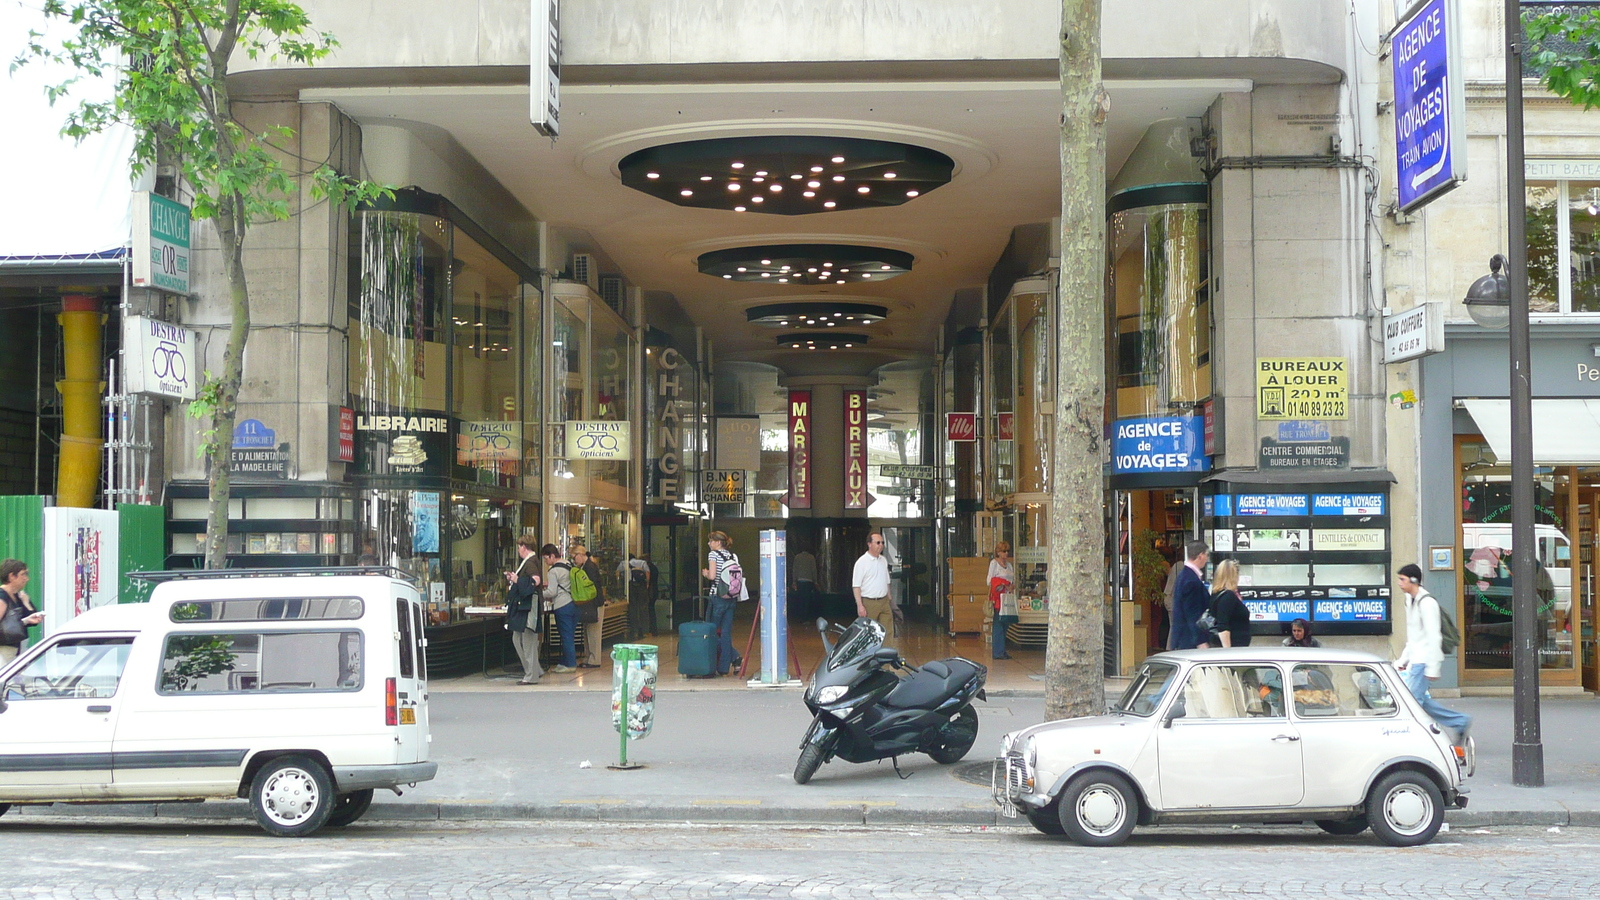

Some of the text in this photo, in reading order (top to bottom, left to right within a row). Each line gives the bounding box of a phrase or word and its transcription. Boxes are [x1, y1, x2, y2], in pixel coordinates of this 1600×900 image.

[1398, 8, 1441, 68] AGENCE
[1412, 59, 1427, 92] DE
[1398, 86, 1442, 141] VOYAGES
[1401, 128, 1442, 172] TRAIN AVION
[1525, 163, 1557, 175] PETIT
[151, 201, 187, 241] CHANGE
[162, 244, 176, 276] OR
[1387, 311, 1423, 340] CLUB COIFFURE
[150, 320, 187, 344] DESTRAY
[1261, 361, 1344, 371] BUREAUX
[1267, 372, 1338, 385] À LOUER
[159, 381, 182, 395] Opticiens
[1288, 401, 1344, 416] 01 40 89 23 23
[244, 422, 256, 434] 11
[357, 415, 448, 433] LIBRAIRIE
[575, 423, 622, 431] DESTRAY
[658, 347, 680, 501] CHANGE
[950, 417, 973, 438] illy
[1118, 422, 1182, 439] AGENCE
[1280, 430, 1293, 439] RUE
[243, 436, 273, 444] TRONCHET
[1137, 440, 1151, 451] de
[580, 450, 614, 458] Opticiens
[849, 394, 862, 506] BUREAUX
[1262, 446, 1344, 455] CENTRE COMMERCIAL
[1116, 453, 1188, 469] VOYAGES
[1270, 458, 1299, 466] BUREAUX
[1302, 458, 1311, 466] EN
[230, 463, 284, 472] LA MADELEINE
[706, 472, 740, 482] B.N.C
[702, 482, 744, 493] Madeleine
[703, 493, 743, 502] CHANGE
[1239, 495, 1306, 508] AGENCE de VOYAGES
[1315, 495, 1381, 507] AGENCE de VOYAGES
[1482, 510, 1498, 523] Pour
[1318, 534, 1346, 543] LENTILLES
[1353, 534, 1378, 543] CONTACT
[1246, 601, 1307, 613] GENCE de VOYAGES
[1316, 601, 1383, 613] AGENCE de VOYAGES
[1499, 608, 1512, 616] dan
